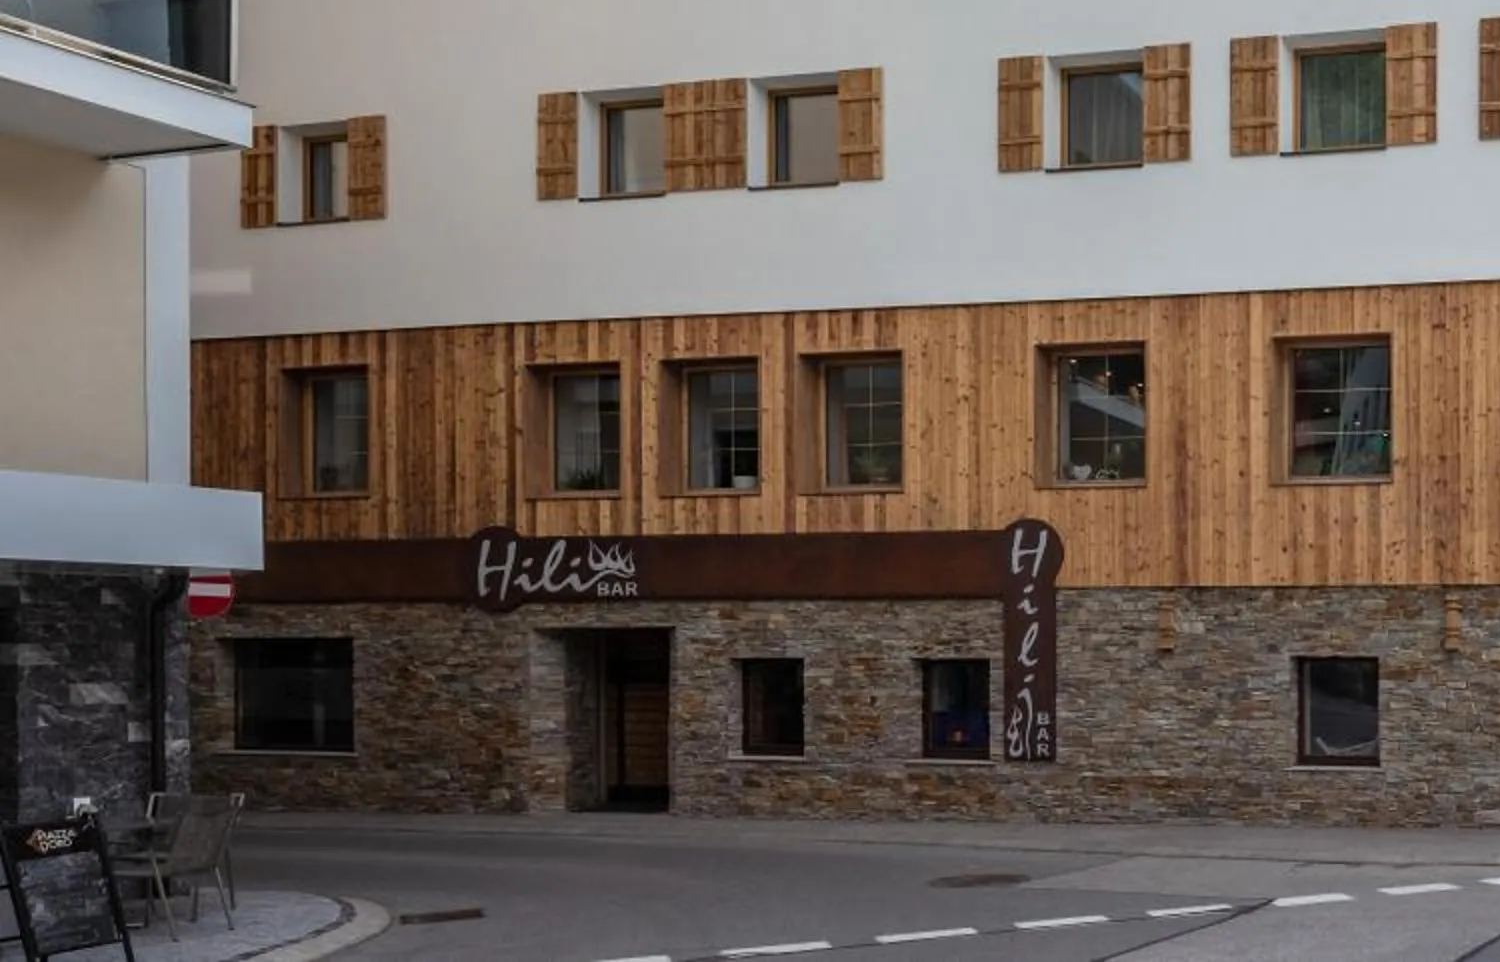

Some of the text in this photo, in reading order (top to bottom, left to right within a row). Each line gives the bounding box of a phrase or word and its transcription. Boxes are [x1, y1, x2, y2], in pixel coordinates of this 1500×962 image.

[476, 539, 598, 601] Hili
[597, 581, 638, 597] BAR
[1037, 712, 1051, 757] BAR
